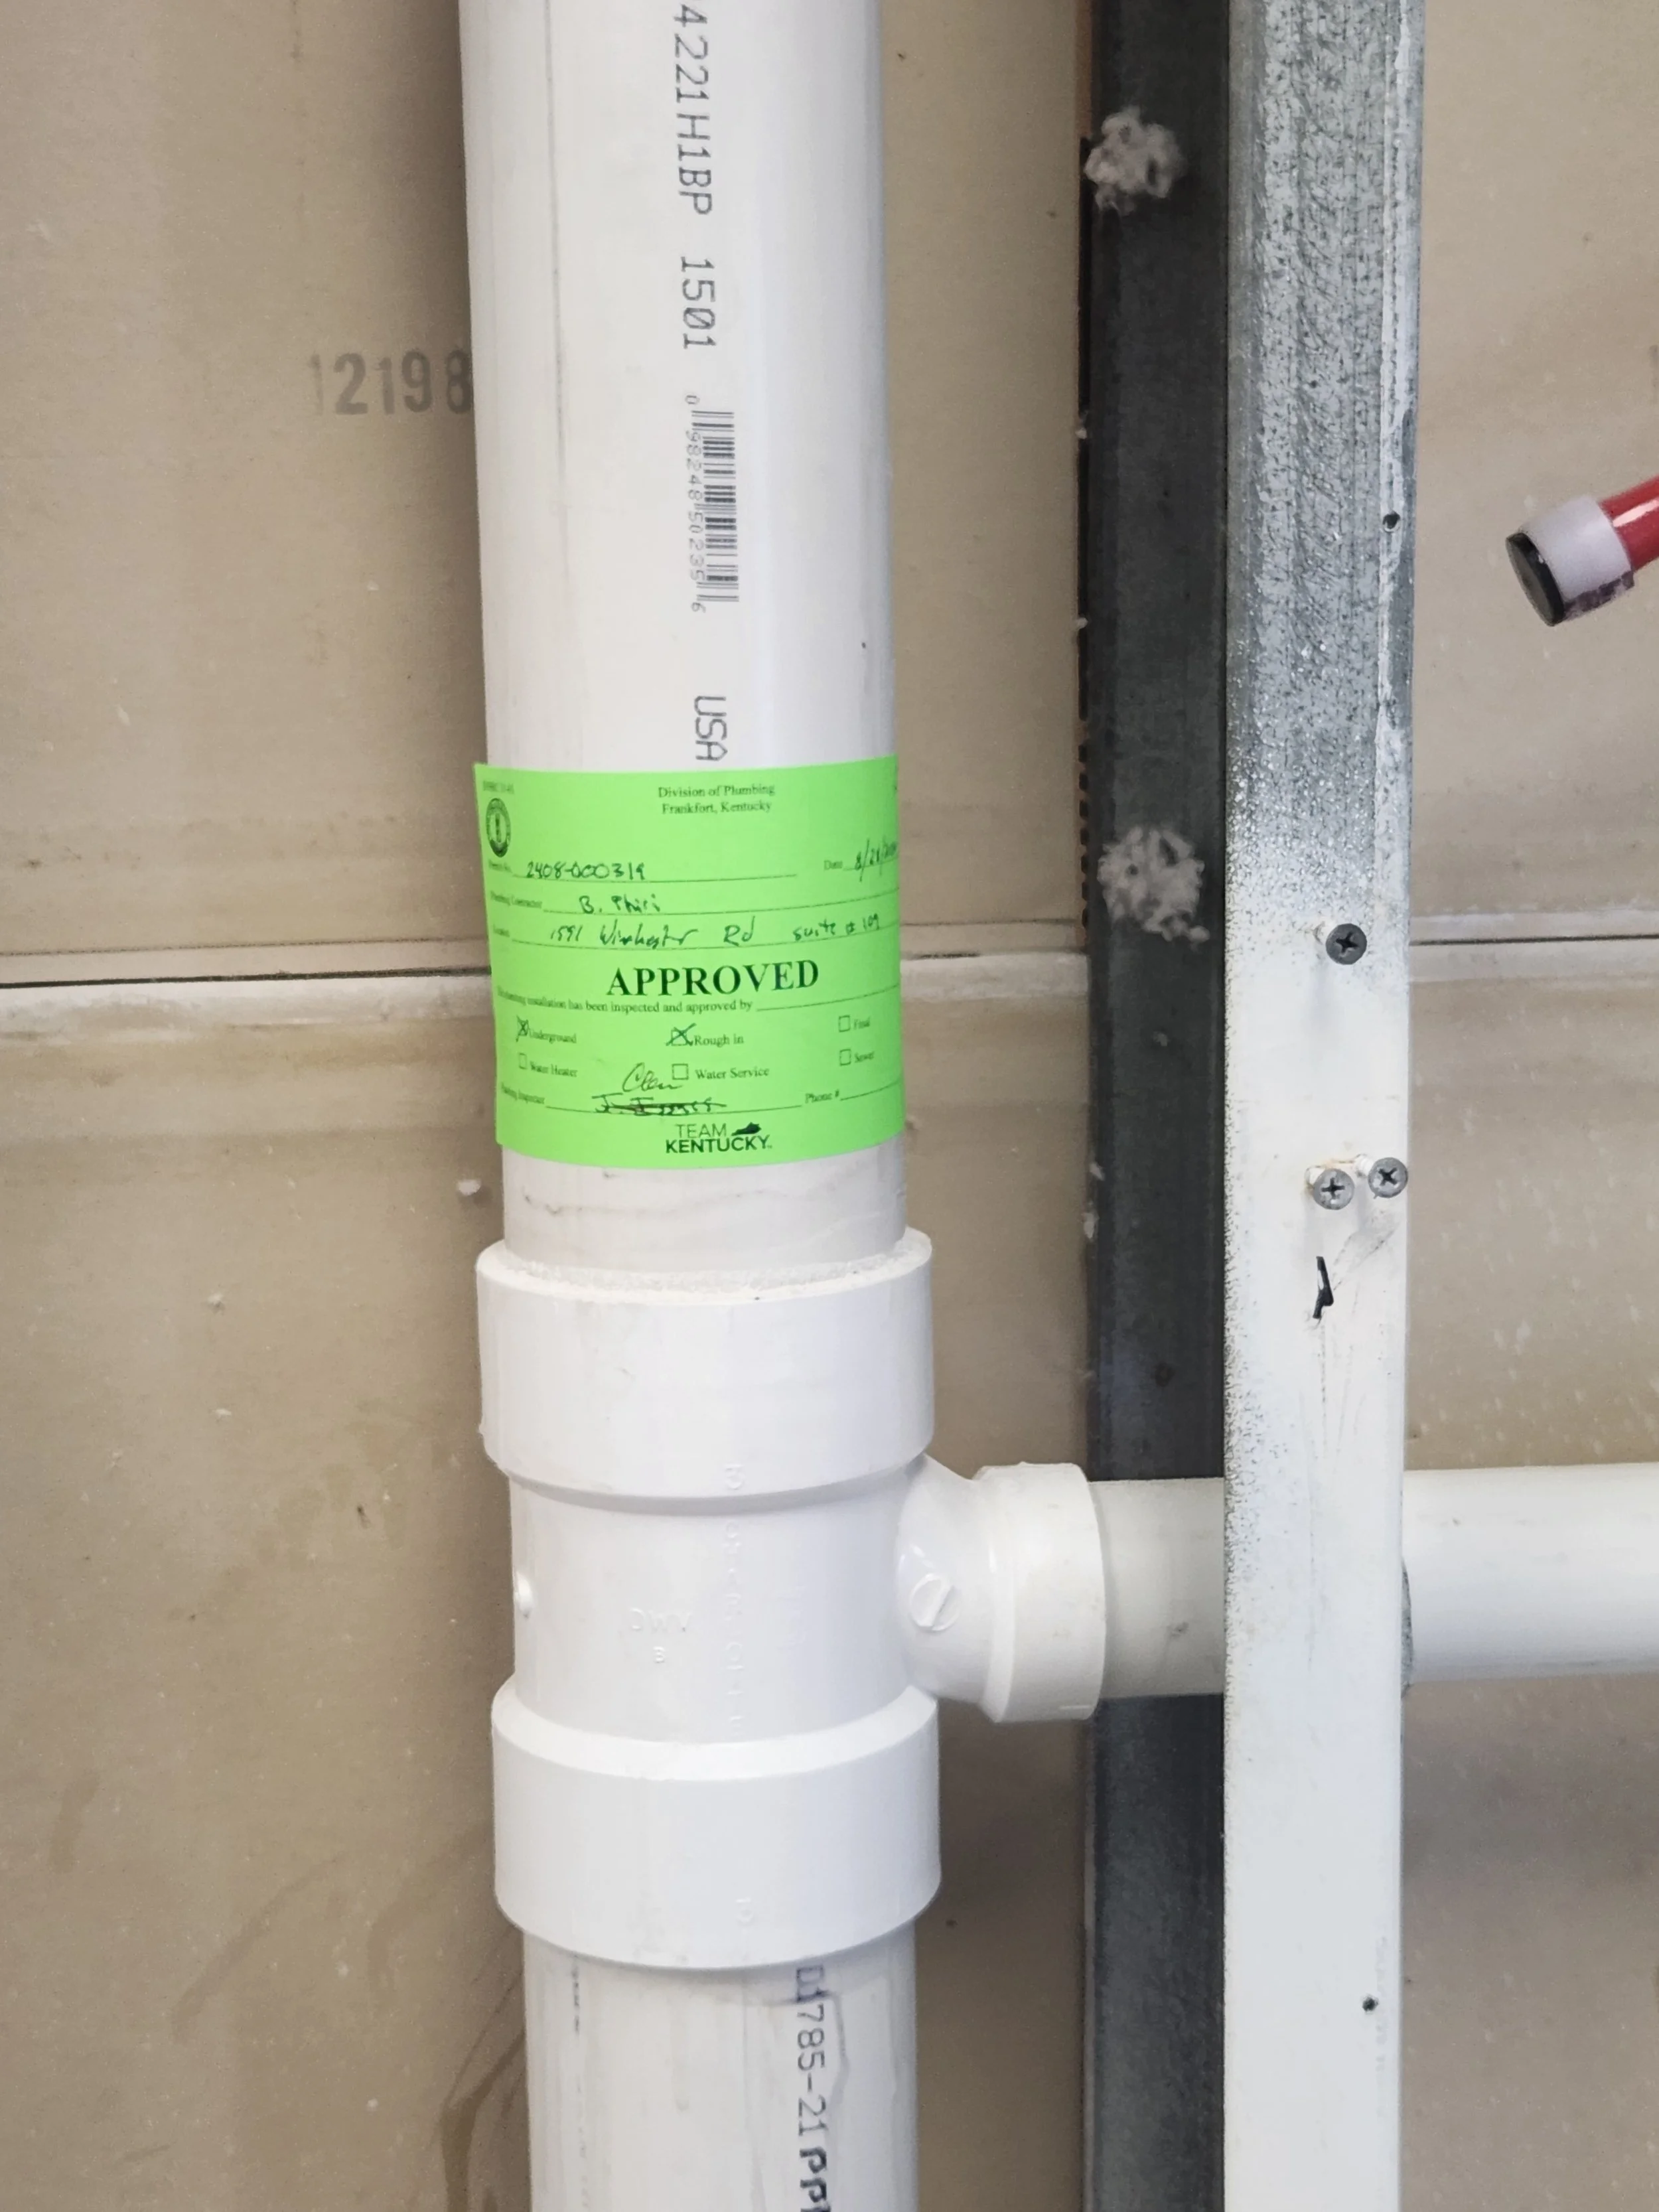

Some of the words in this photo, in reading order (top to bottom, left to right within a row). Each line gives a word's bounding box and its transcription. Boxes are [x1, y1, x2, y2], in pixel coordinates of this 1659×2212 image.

[693, 695, 729, 762] USA
[658, 785, 705, 798] Division
[708, 785, 721, 796] of
[724, 783, 775, 797] Plumbing
[662, 802, 717, 815] Frankfort,
[720, 800, 772, 813] Kentucky
[606, 959, 819, 997] APPROVED
[585, 999, 608, 1011] been
[611, 1001, 660, 1016] inspected
[663, 1001, 683, 1013] and
[686, 999, 737, 1015] approved
[740, 999, 753, 1013] by
[694, 1033, 731, 1048] Rough
[733, 1033, 745, 1045] in
[695, 1068, 727, 1080] Water
[730, 1066, 770, 1078] Service
[674, 1123, 727, 1139] TEAM
